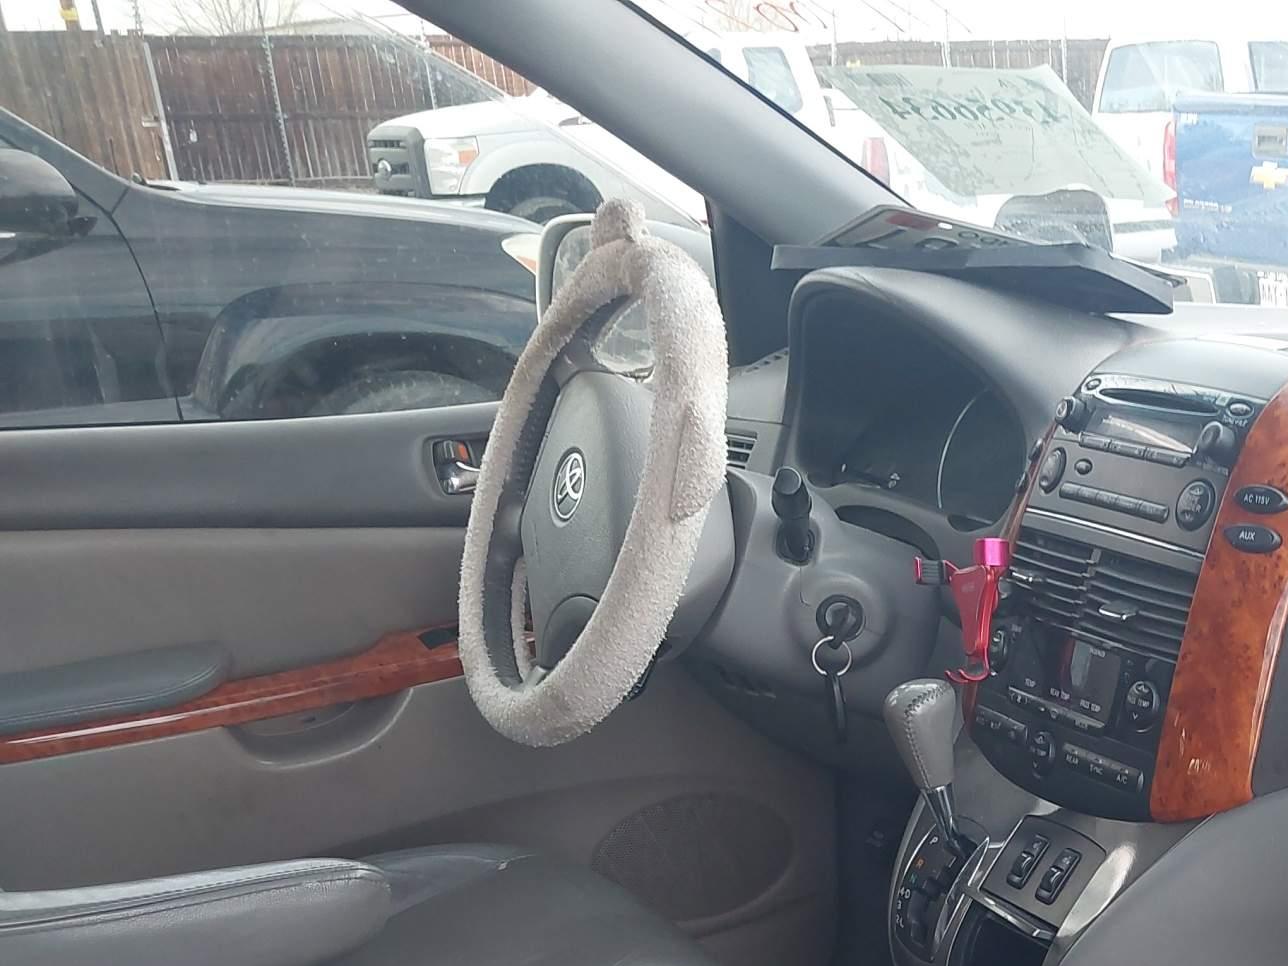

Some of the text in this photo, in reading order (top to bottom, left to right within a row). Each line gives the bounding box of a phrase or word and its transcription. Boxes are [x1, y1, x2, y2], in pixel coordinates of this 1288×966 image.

[1243, 493, 1254, 504] AC
[1239, 530, 1256, 541] AUX
[1116, 773, 1128, 785] A/C
[930, 836, 939, 845] P
